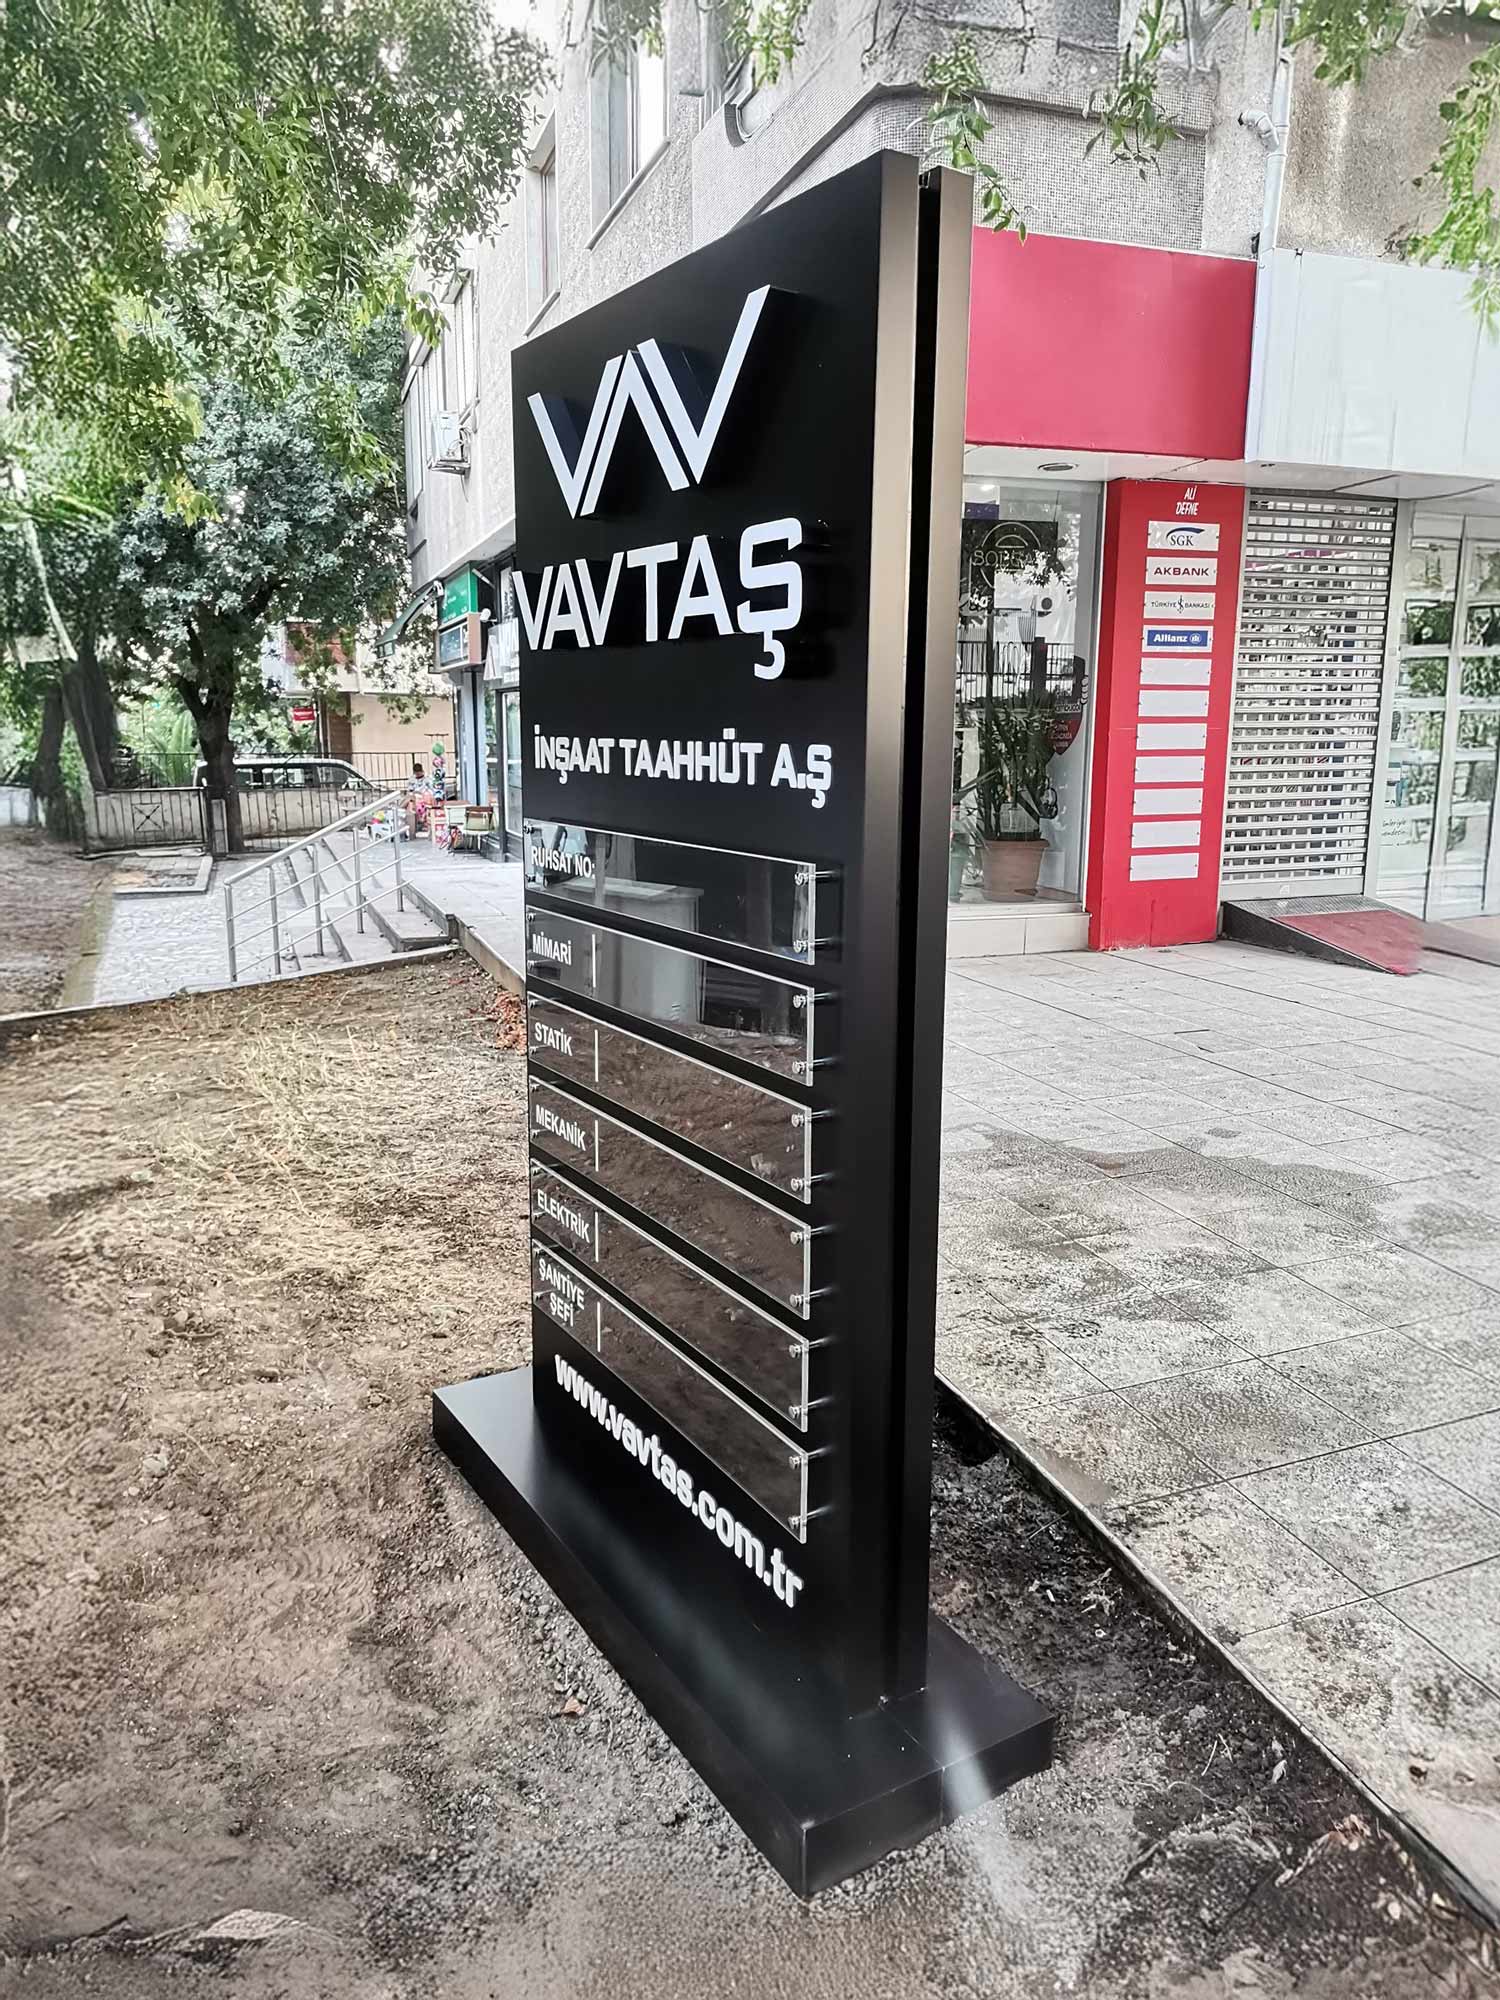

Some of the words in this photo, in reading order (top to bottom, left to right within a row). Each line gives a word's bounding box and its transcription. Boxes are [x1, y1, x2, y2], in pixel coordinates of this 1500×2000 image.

[1170, 534, 1194, 546] SGK
[1153, 567, 1210, 577] AKBANK
[512, 517, 803, 681] VAVTAŞ
[1153, 633, 1188, 643] Allianz
[534, 724, 615, 785] İNŞAAT
[618, 727, 764, 786] TAAHHÜT
[770, 743, 832, 809] A.Ş
[531, 846, 573, 875] RUHSAT
[574, 854, 596, 880] NO:
[532, 931, 572, 966] MİMARİ
[534, 1021, 573, 1057] STATİK
[535, 1103, 587, 1152] MEKANİK
[537, 1188, 591, 1244] ELEKTRİK
[538, 1257, 586, 1311] ŞANTİYE
[549, 1291, 575, 1328] ŞEFİ
[554, 1353, 804, 1609] www.vavtas.com.tr
